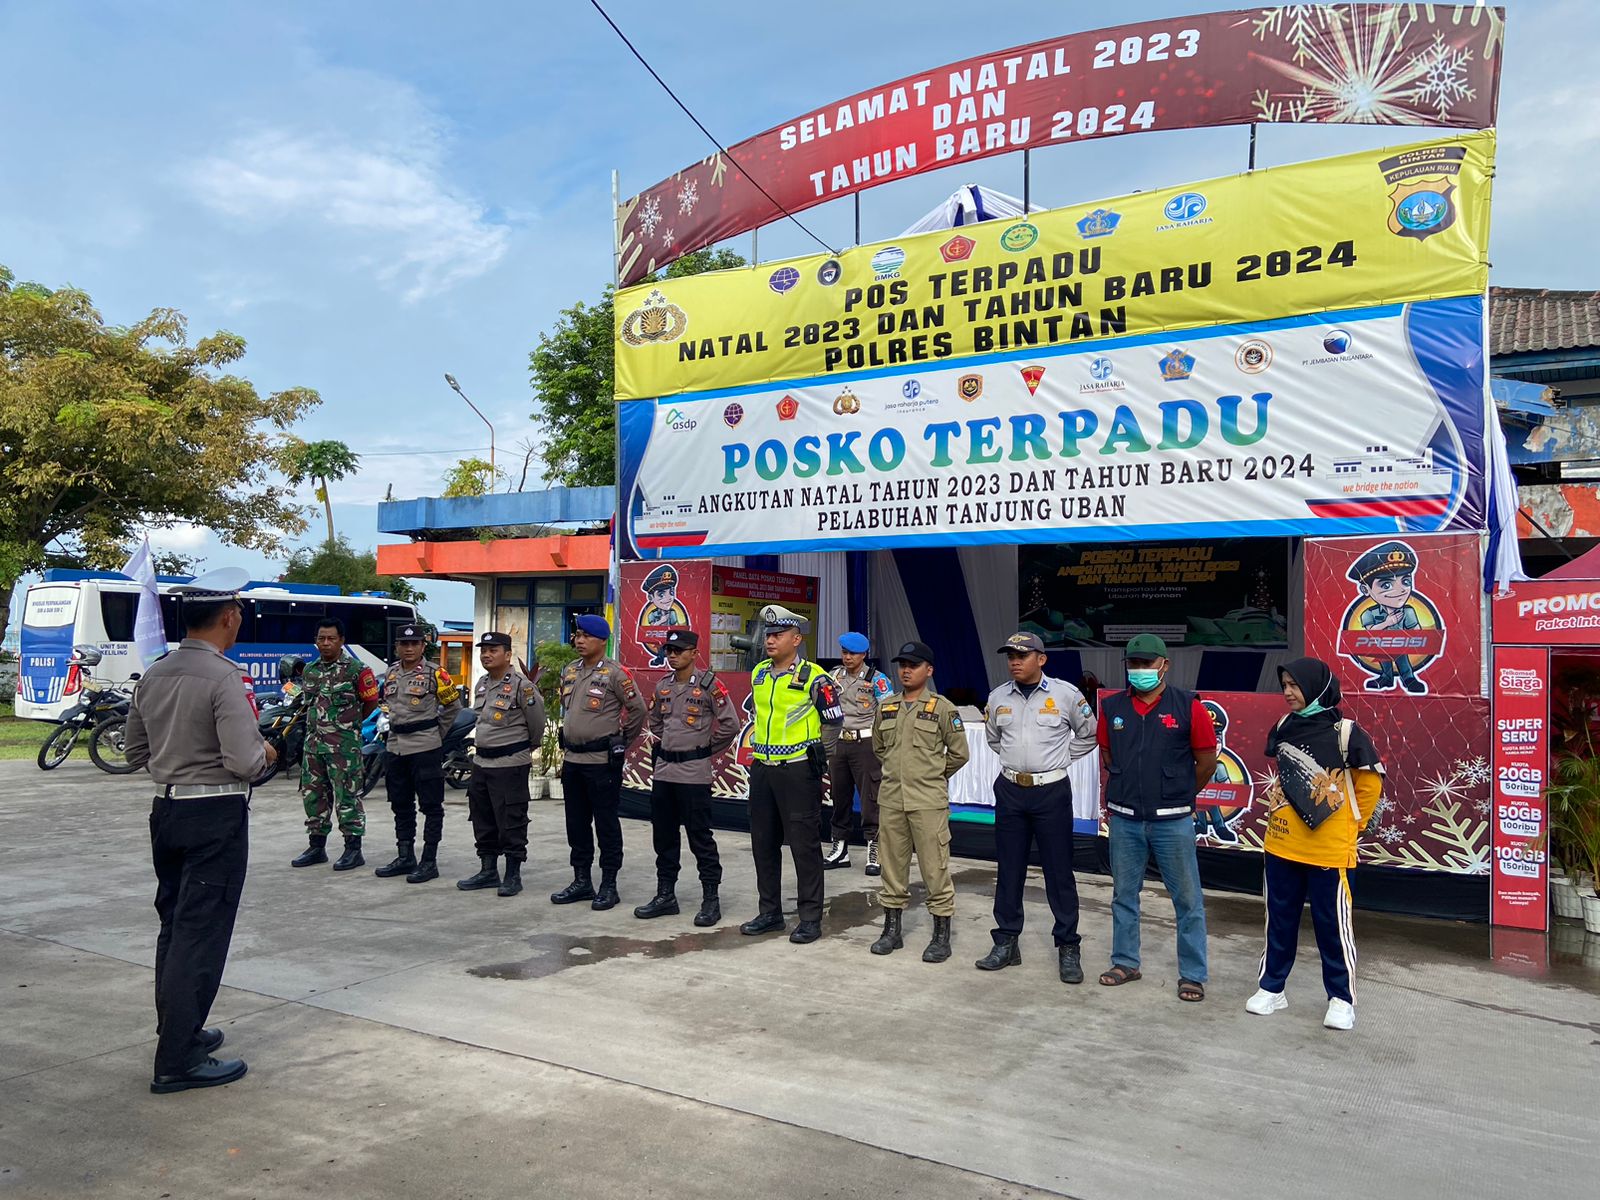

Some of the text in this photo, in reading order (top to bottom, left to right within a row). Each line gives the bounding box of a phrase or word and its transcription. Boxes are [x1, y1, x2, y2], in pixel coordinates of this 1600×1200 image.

[780, 29, 1200, 151] SELAMAT NATAL 2023
[933, 89, 1006, 131] DAN
[810, 100, 1155, 197] TAHUN BARU 2024
[1398, 147, 1446, 160] POLRES
[1399, 153, 1445, 165] BINTAN
[1389, 164, 1456, 181] KEPULAUAN RIAU
[1156, 217, 1214, 232] JASA RAHARJA
[845, 245, 1101, 313] POS TERPADU
[874, 271, 901, 282] BMKG
[678, 239, 1357, 362] NATAL 2023 DAN TAHUN BARU 2024
[825, 305, 1127, 372] POLRES BINTAN
[1309, 357, 1339, 366] JEMBATAN
[1339, 353, 1374, 362] NUSANTARA
[1079, 383, 1095, 392] JASA
[1095, 380, 1125, 390] RAHARJA
[885, 402, 897, 410] jasa
[897, 400, 918, 408] raharja
[672, 419, 697, 431] asdp
[721, 391, 1274, 484] POSKO TERPADU
[697, 453, 1315, 514] ANGKUTAN NATAL TAHUN 2023 DAN TAHUN BARU 2024
[1343, 480, 1419, 494] we bridge the nation
[817, 494, 1127, 532] PELABUHAN TANJUNG UBAN
[1080, 546, 1214, 565] POSKO TERPADU
[1161, 561, 1202, 573] TAHUN
[1077, 573, 1102, 585] DAN
[1103, 585, 1157, 594] Transportasi
[1519, 592, 1600, 617] PROMO
[1536, 616, 1577, 631] Paket
[1355, 636, 1427, 648] PRESISI
[30, 657, 55, 667] POLISI
[1501, 676, 1541, 690] Siaga
[686, 697, 703, 705] POLRI
[1497, 718, 1542, 730] SUPER
[1501, 730, 1538, 743] SERU
[1498, 767, 1542, 782] 20GB
[1505, 782, 1535, 791] 50ribu
[1196, 788, 1237, 801] ESISI
[1498, 805, 1542, 821] 50GB
[1503, 821, 1537, 831] 100ribu
[1495, 846, 1545, 862] 100GB
[1502, 862, 1537, 872] 150ribu
